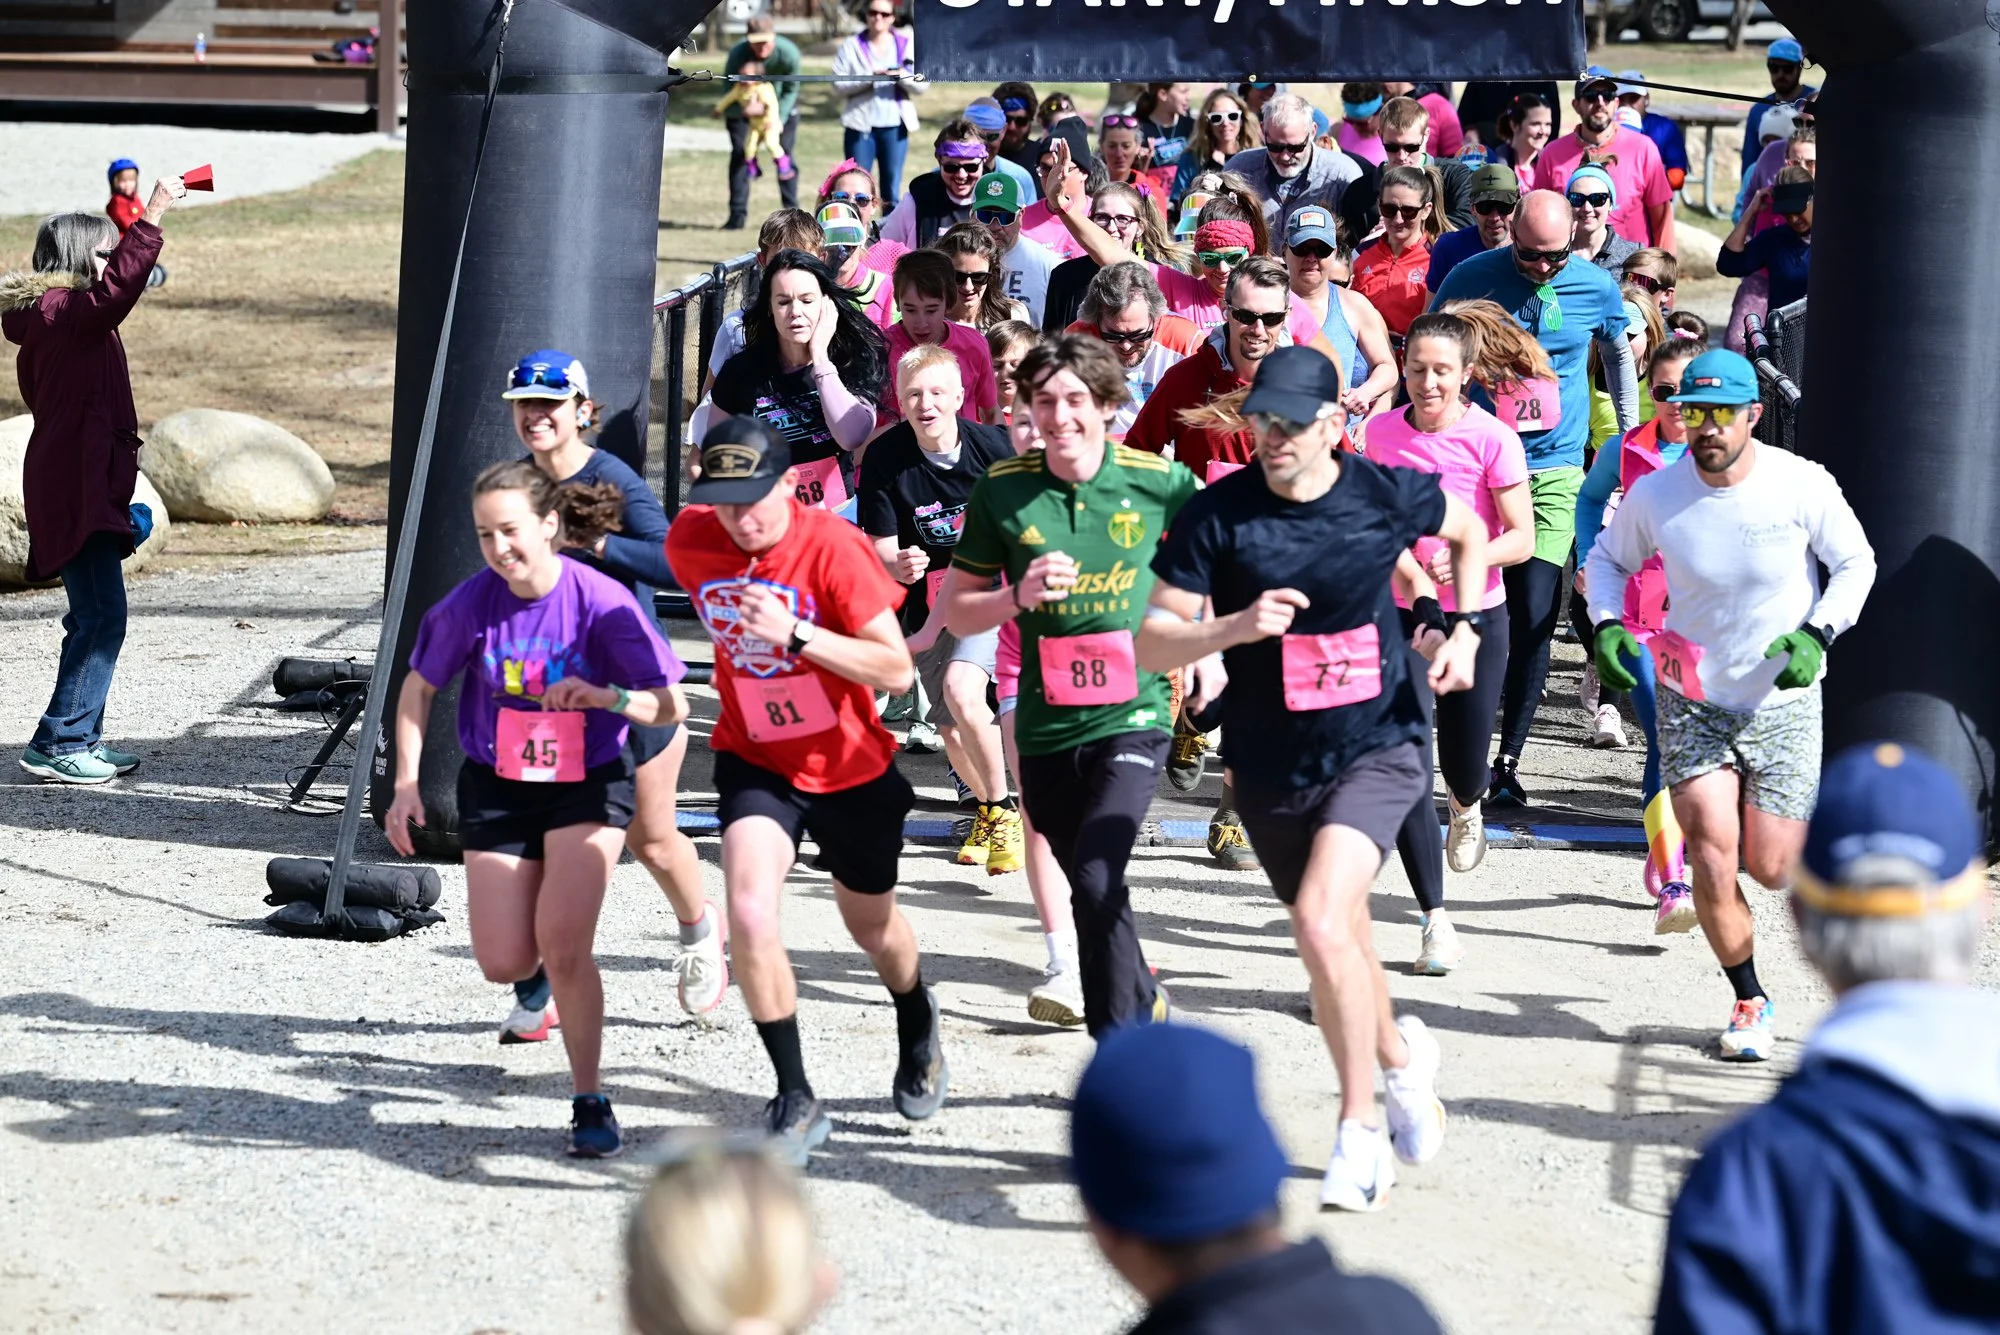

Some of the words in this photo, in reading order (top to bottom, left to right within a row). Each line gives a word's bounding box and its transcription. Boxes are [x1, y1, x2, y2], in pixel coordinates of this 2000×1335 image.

[1514, 398, 1542, 421] 28
[795, 480, 825, 506] 68
[1071, 659, 1107, 689] 88
[1314, 660, 1352, 690] 72
[1660, 651, 1682, 683] 20
[765, 700, 805, 727] 81
[521, 738, 558, 767] 45
